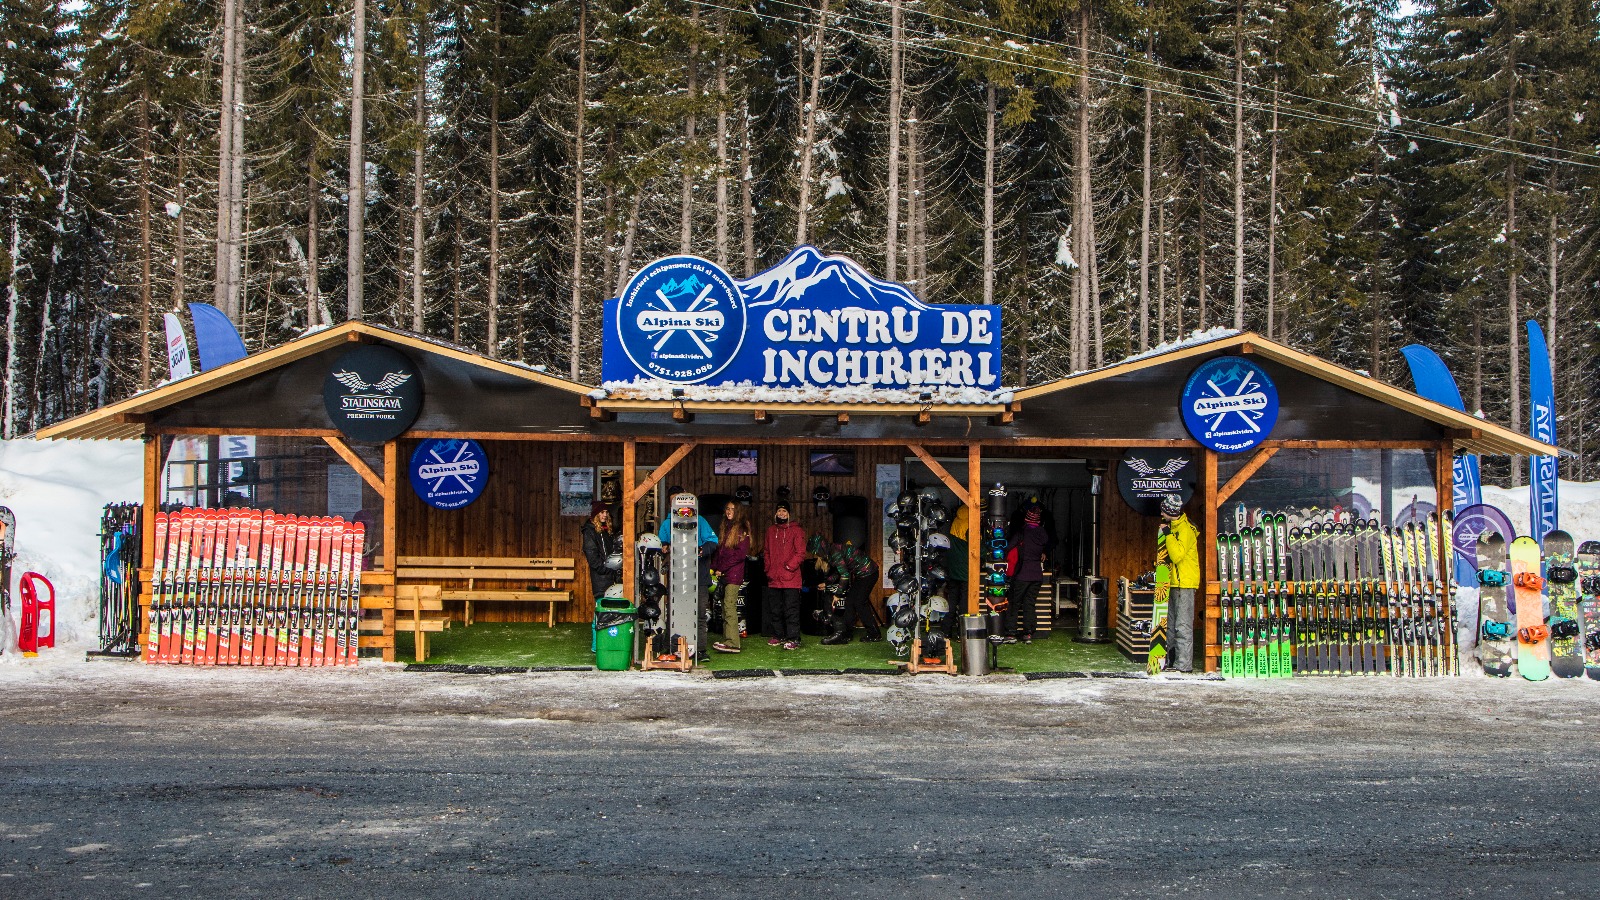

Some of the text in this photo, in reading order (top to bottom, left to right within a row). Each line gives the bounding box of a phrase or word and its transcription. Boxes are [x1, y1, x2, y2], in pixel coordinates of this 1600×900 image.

[650, 263, 692, 277] echipament
[692, 264, 705, 272] ski
[712, 273, 738, 309] snowboard
[642, 317, 720, 328] Alpina Ski
[763, 308, 993, 344] CENTRU DE
[648, 362, 713, 378] 0751.928.086
[762, 349, 996, 385] INCHIRIERI
[342, 397, 402, 409] STALINSKAYA
[1196, 396, 1266, 410] Alpina Ski
[421, 466, 457, 475] Alpina
[1132, 480, 1181, 489] STALINSKAYA
[1265, 525, 1274, 567] HEAD
[1277, 525, 1286, 567] HEAD
